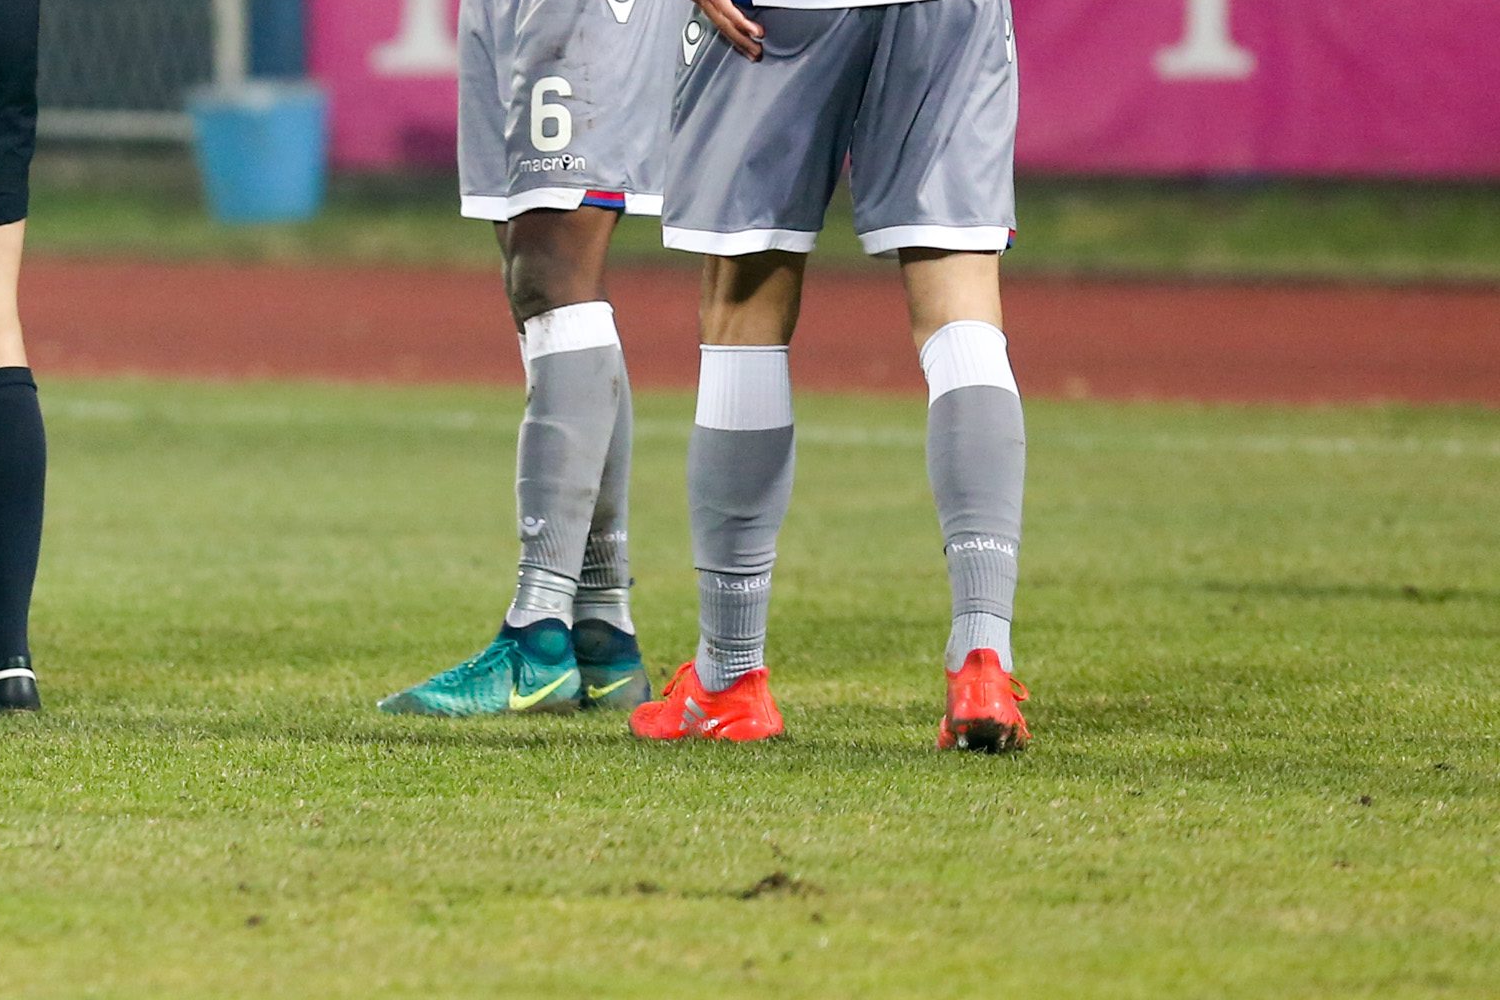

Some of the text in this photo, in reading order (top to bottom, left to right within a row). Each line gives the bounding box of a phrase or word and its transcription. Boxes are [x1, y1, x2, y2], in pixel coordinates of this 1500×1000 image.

[530, 75, 573, 152] 6
[520, 154, 586, 172] macron
[951, 537, 1015, 557] hajduk
